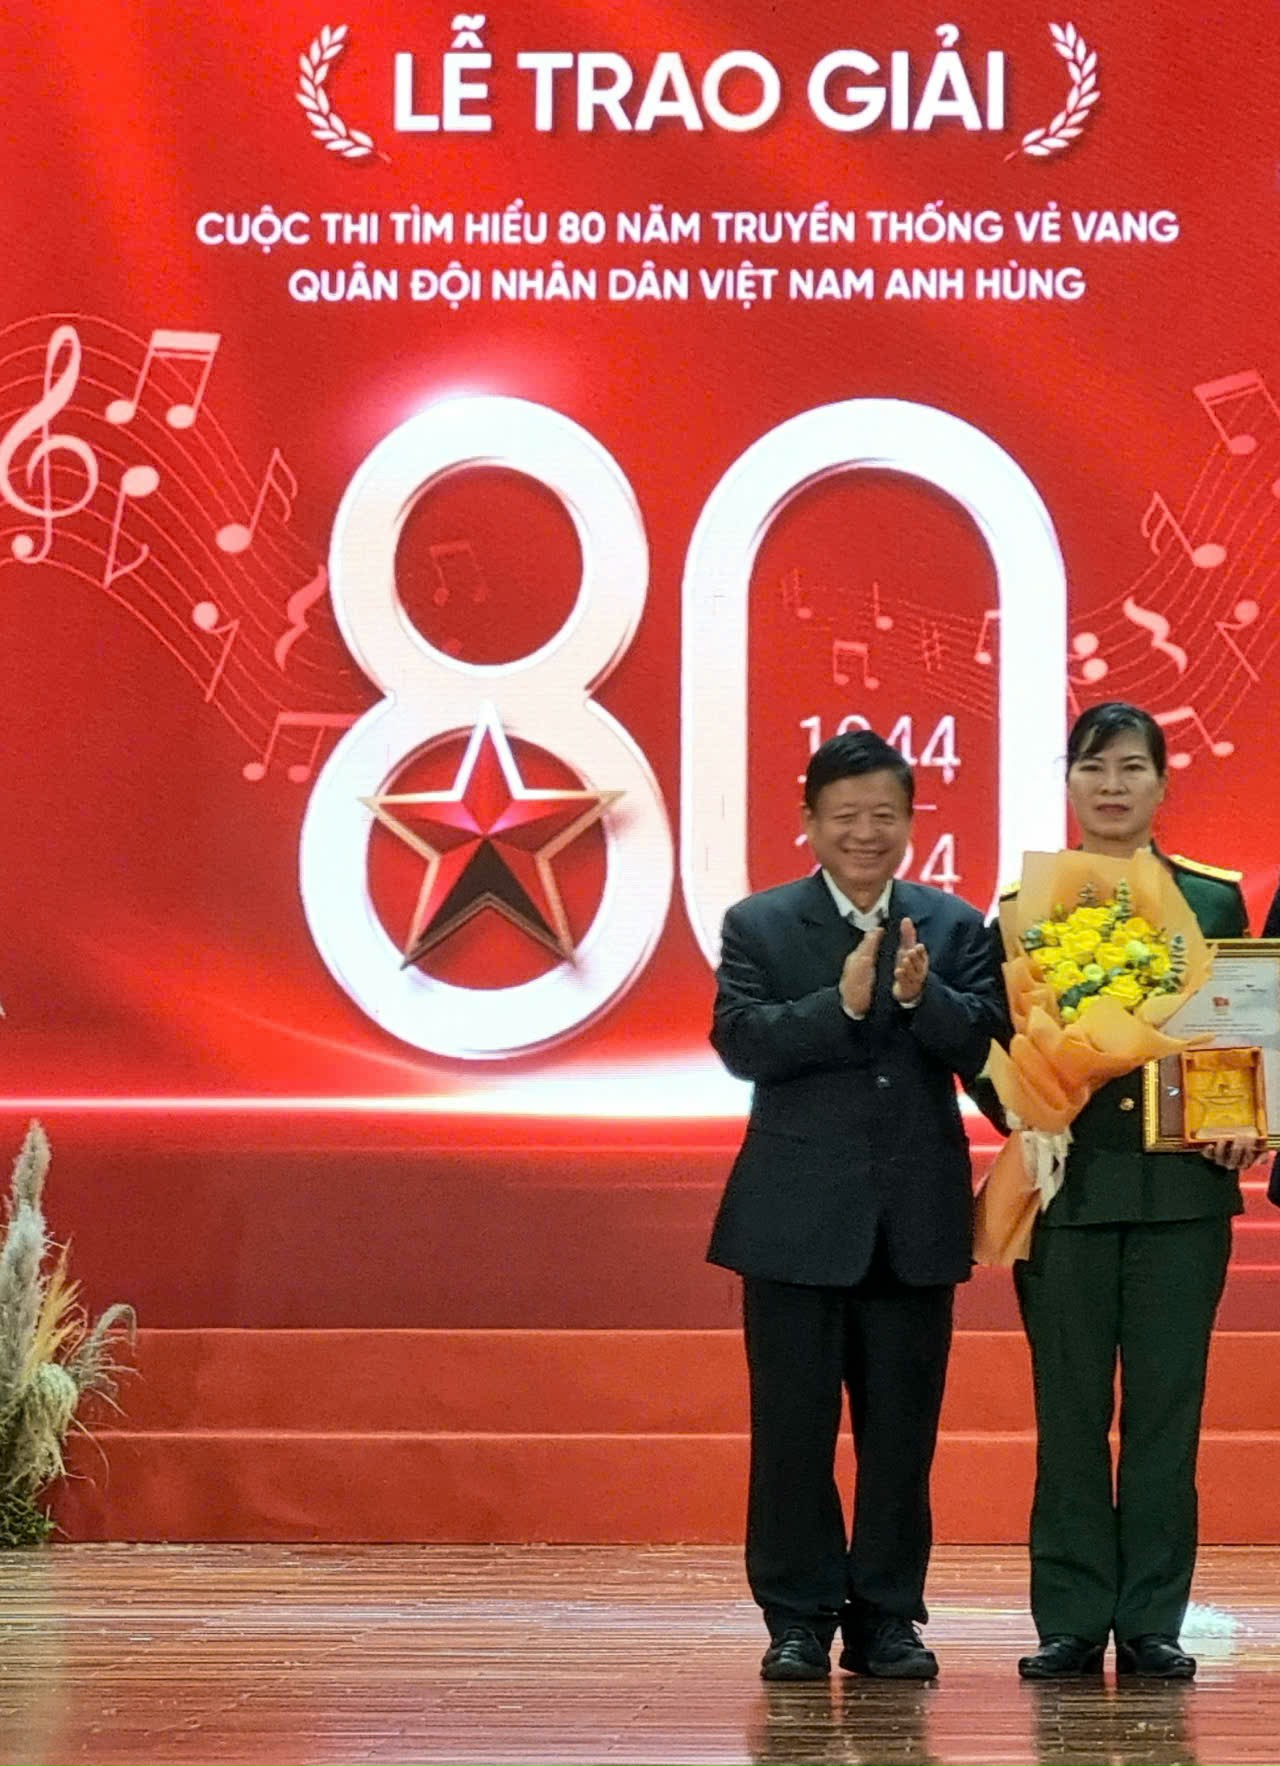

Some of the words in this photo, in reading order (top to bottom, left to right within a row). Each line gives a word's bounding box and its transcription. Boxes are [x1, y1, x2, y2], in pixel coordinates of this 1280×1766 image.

[394, 14, 494, 133] LỄ
[517, 50, 782, 134] TRAO
[807, 24, 1006, 133] GIẢI
[196, 205, 310, 253] CUỘC
[321, 213, 379, 245] THI
[390, 204, 454, 245] TÌM
[465, 198, 548, 245] HIỂU
[558, 212, 606, 245] 80
[617, 204, 701, 245] NĂM
[866, 200, 1004, 244] THỐNG
[1015, 202, 1061, 244] VẺ
[1072, 211, 1180, 244] VANG
[288, 261, 399, 303] QUÂN
[410, 261, 482, 310] ĐỘI
[492, 261, 597, 302] NHÂN
[609, 261, 689, 301] DÂN
[699, 261, 779, 310] VIỆT
[790, 268, 875, 301] NAM
[885, 268, 965, 301] ANH
[976, 260, 1087, 301] HÙNG
[299, 396, 1068, 1059] 80
[798, 715, 962, 784] 144
